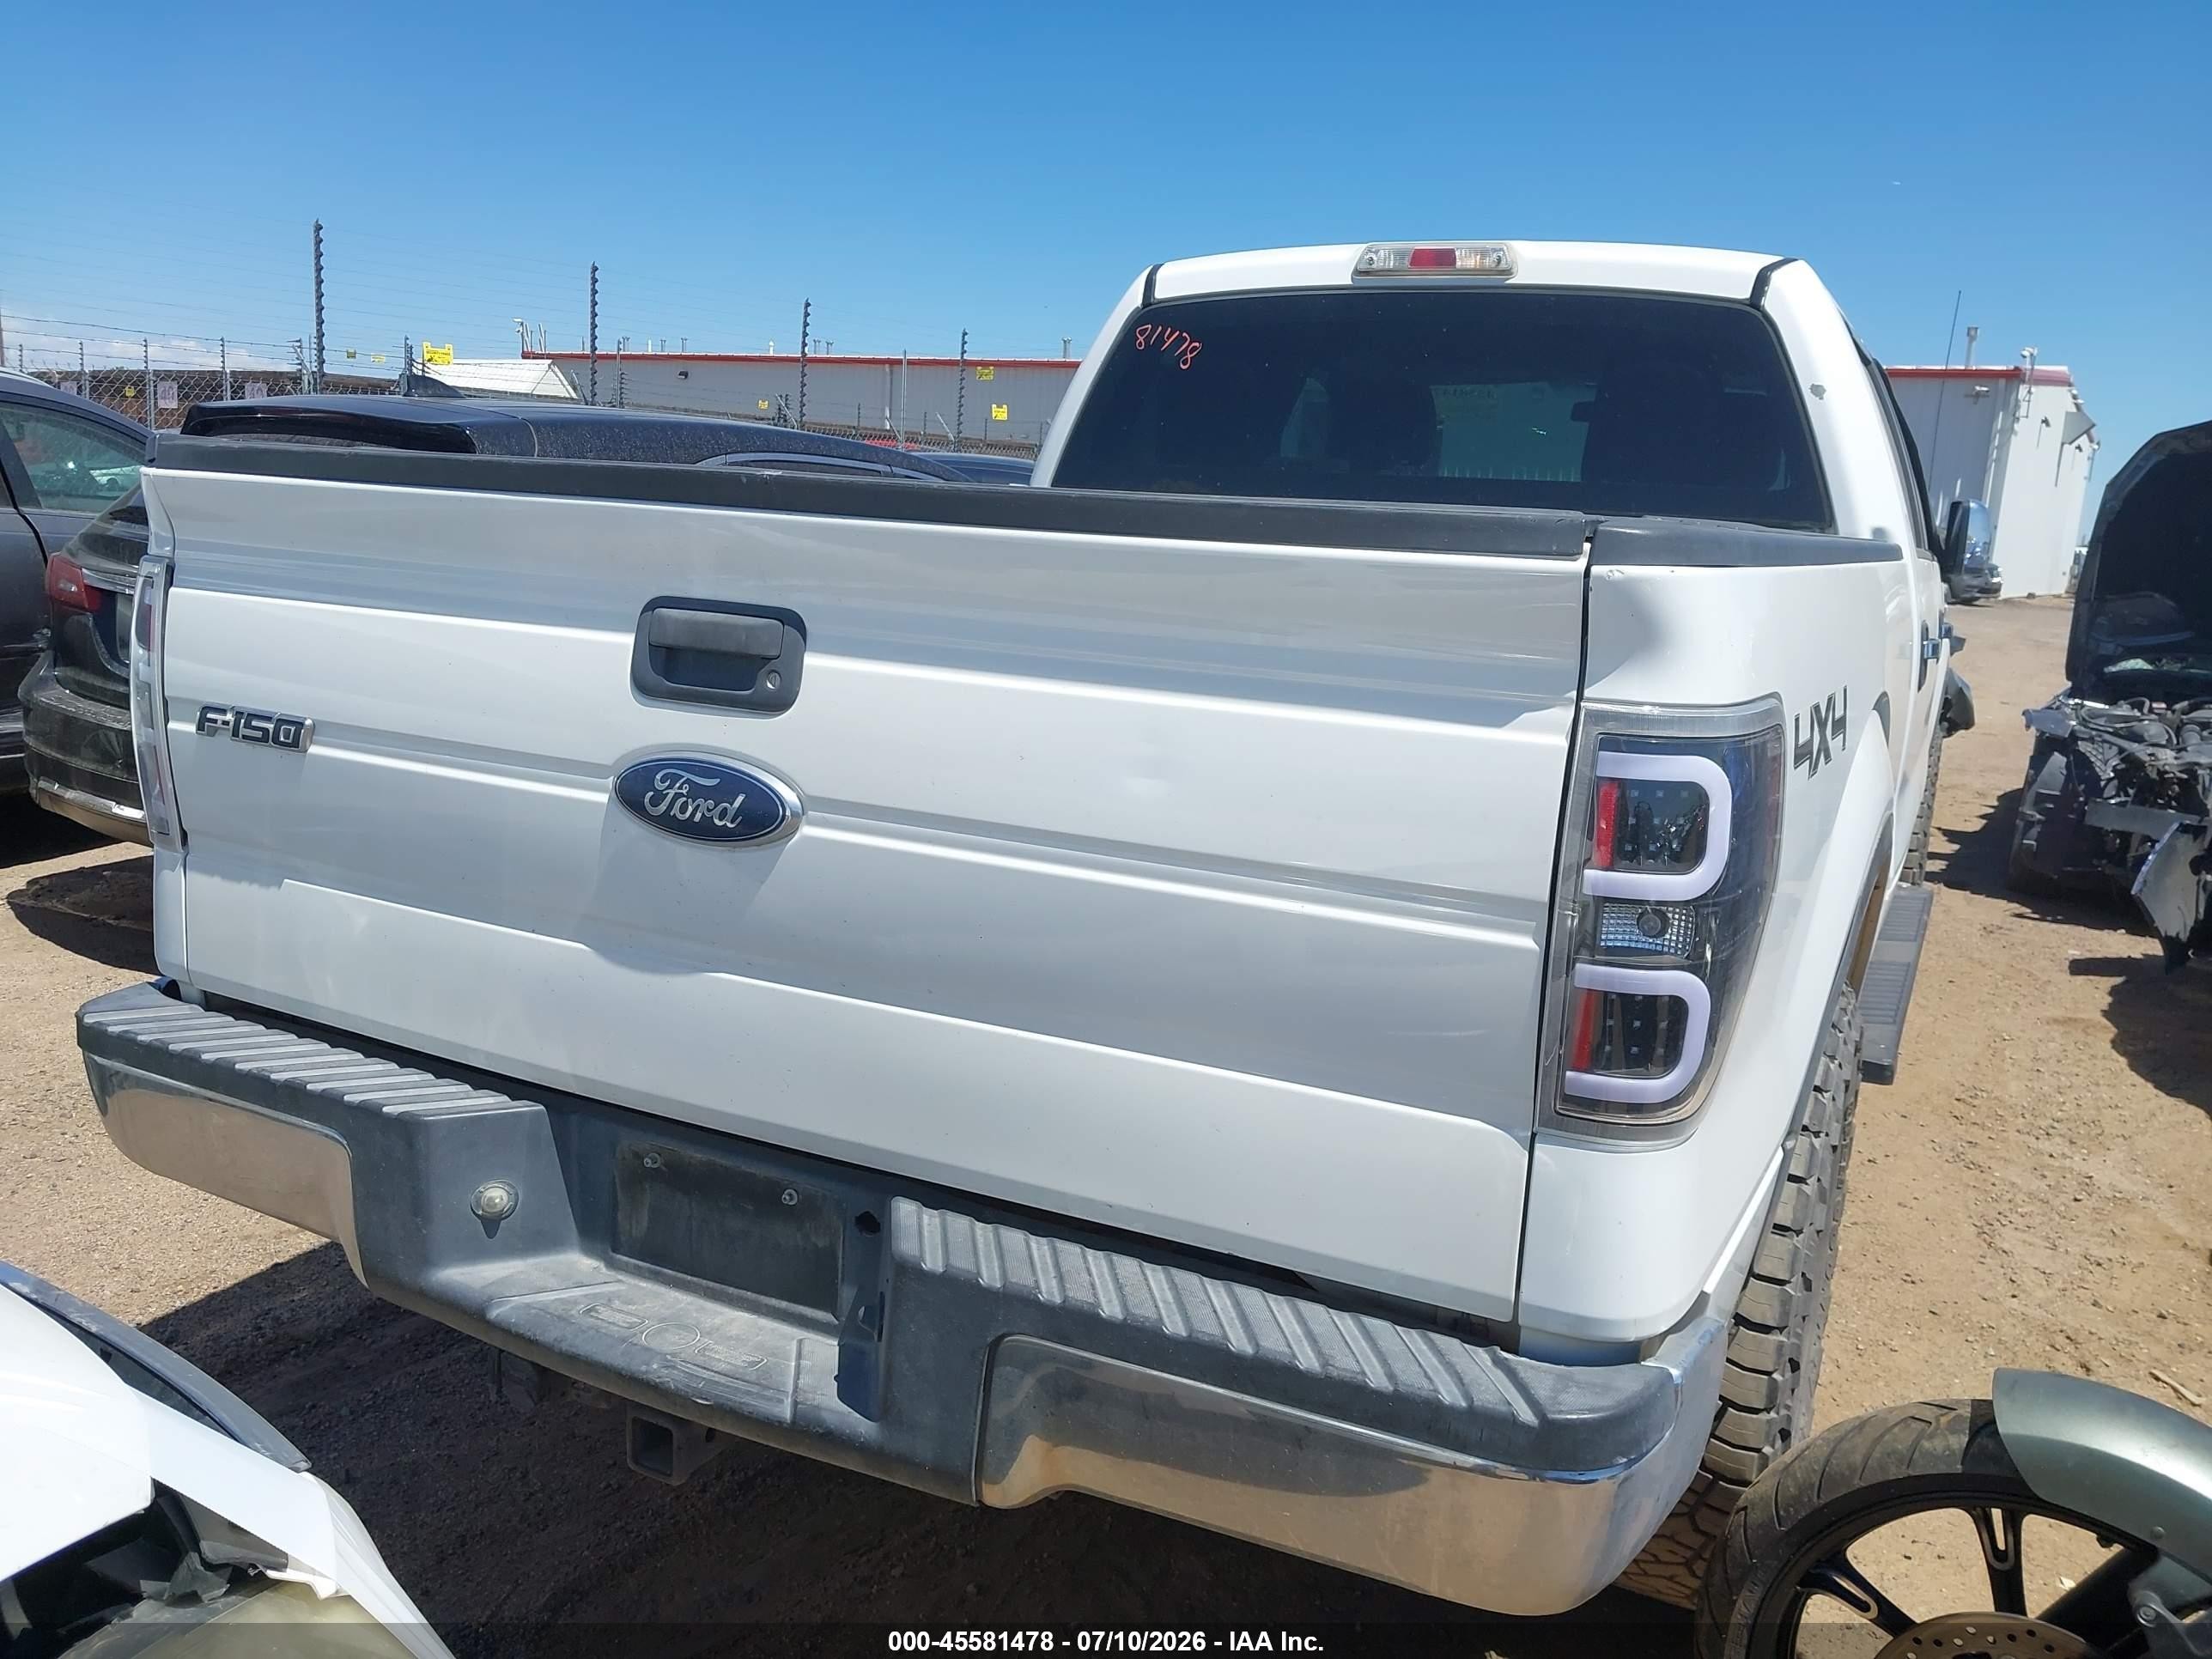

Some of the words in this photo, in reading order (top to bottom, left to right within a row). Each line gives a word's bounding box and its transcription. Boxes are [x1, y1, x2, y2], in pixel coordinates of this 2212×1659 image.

[1136, 325, 1202, 369] 81478
[197, 703, 309, 751] F-150
[645, 769, 746, 828] Ford
